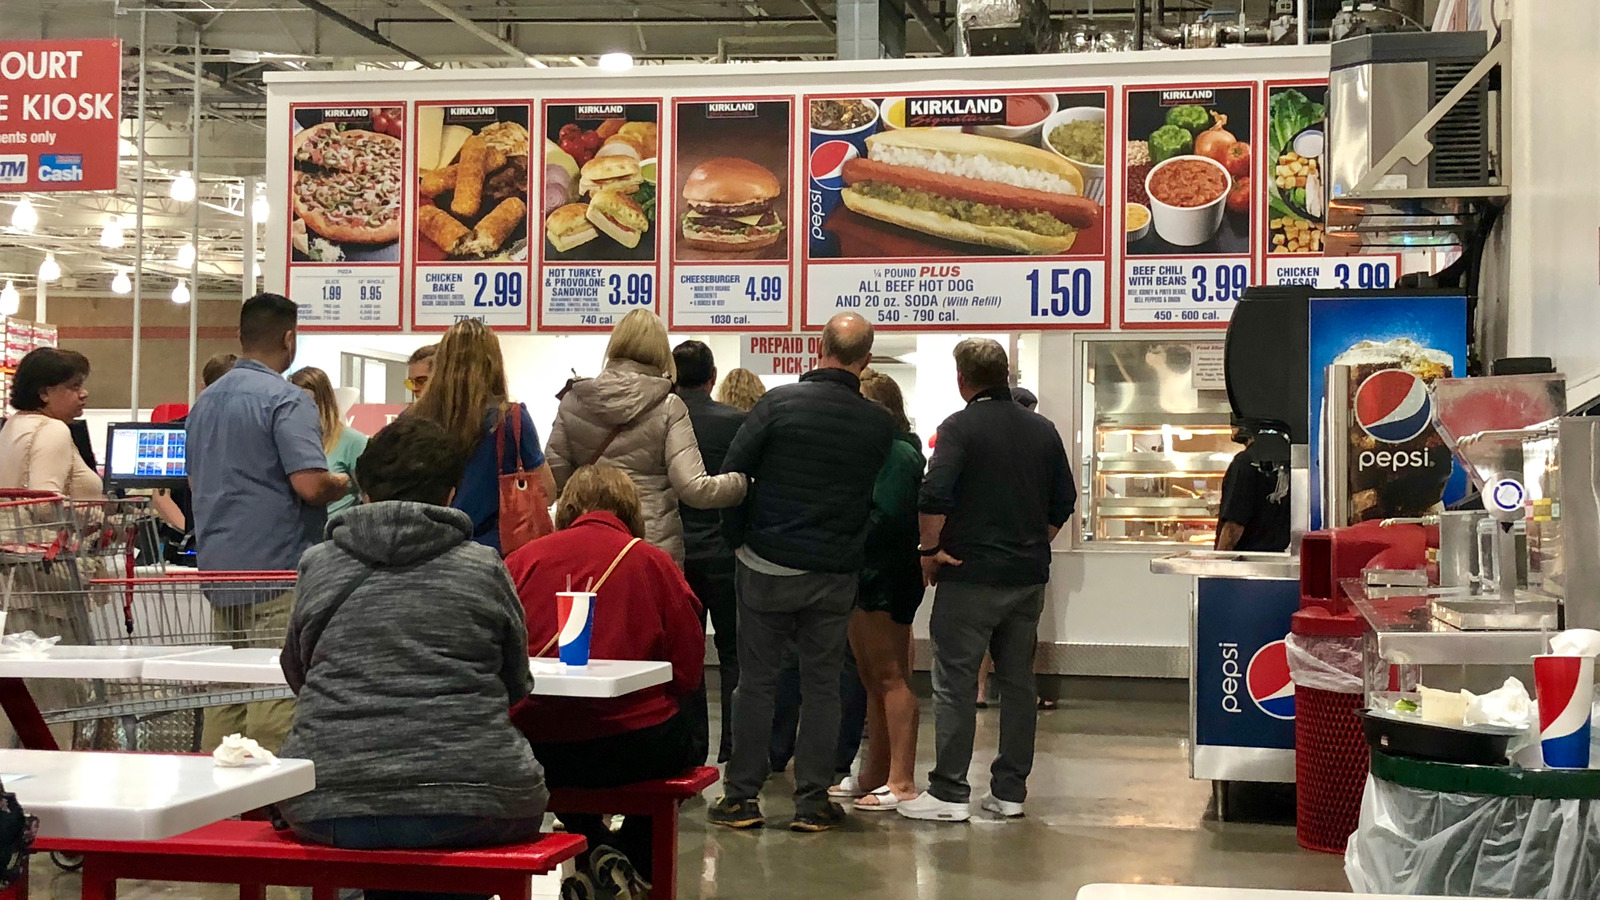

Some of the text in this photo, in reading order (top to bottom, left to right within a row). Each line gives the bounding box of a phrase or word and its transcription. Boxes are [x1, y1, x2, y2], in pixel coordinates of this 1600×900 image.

[0, 51, 83, 80] OURT
[1163, 90, 1213, 100] KIRKLAND
[22, 93, 114, 121] KIOSK
[324, 108, 369, 117] KIRKLAND
[450, 107, 495, 116] KIRKLAND
[578, 105, 623, 114] KIRKLAND
[709, 103, 755, 112] KIRKLAND
[910, 98, 1003, 115] KIRKLAND
[0, 130, 57, 146] ents only
[38, 165, 83, 182] Cash
[810, 189, 826, 240] pepsi
[548, 268, 603, 278] HOT TURKEY
[884, 268, 917, 278] POUND
[919, 266, 961, 278] PLUS
[1132, 265, 1183, 275] BEEF CHILI
[1277, 267, 1320, 277] CHICKEN
[425, 273, 463, 282] CHICKEN
[545, 278, 606, 287] & PROVOLONE
[680, 274, 741, 284] CHEESEBURGER
[1128, 276, 1187, 286] WITH BEANS
[1191, 264, 1247, 303] 3.99
[432, 283, 455, 292] BAKE
[473, 271, 522, 307] 2.99
[552, 287, 598, 297] SANDWICH
[608, 273, 653, 306] 3.99
[745, 276, 782, 302] 4.99
[859, 279, 974, 293] ALL BEEF HOT DOG
[1025, 268, 1092, 317] 1.50
[321, 285, 342, 301] 1.99
[360, 285, 382, 301] 9.95
[835, 294, 1002, 308] AND 20 oz. SODA (With Refill)
[580, 315, 597, 324] 740
[710, 314, 750, 324] 1030 cal.
[878, 309, 900, 322] 540
[912, 309, 935, 322] 790
[938, 309, 960, 322] cal.
[1154, 310, 1172, 320] 450
[1181, 310, 1199, 320] 600
[1202, 310, 1220, 320] cal.
[750, 337, 804, 354] PREPAID
[1358, 447, 1430, 472] pepsi
[1218, 642, 1243, 713] pepsi
